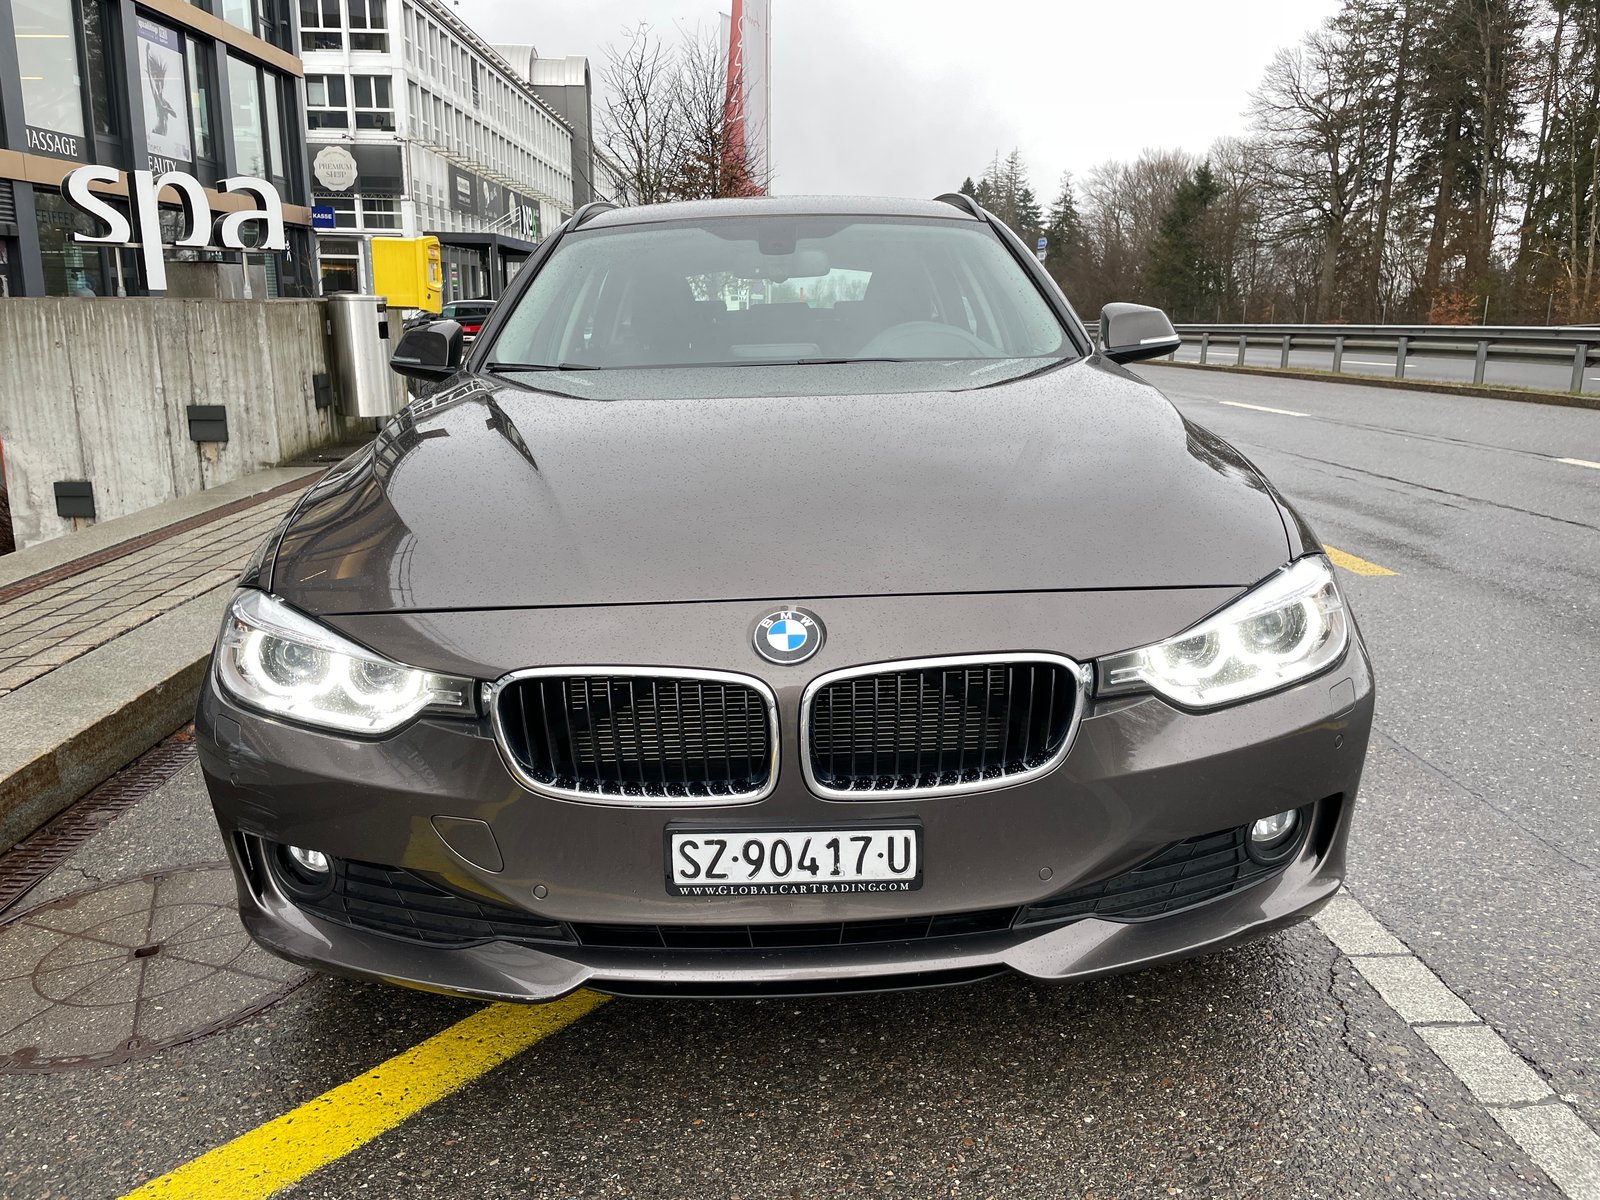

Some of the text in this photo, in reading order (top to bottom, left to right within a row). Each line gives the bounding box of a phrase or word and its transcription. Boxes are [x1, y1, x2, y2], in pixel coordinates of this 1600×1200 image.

[148, 156, 177, 173] EAUTY
[312, 212, 332, 220] KASSE
[61, 164, 285, 291] spa
[760, 611, 814, 629] BMW
